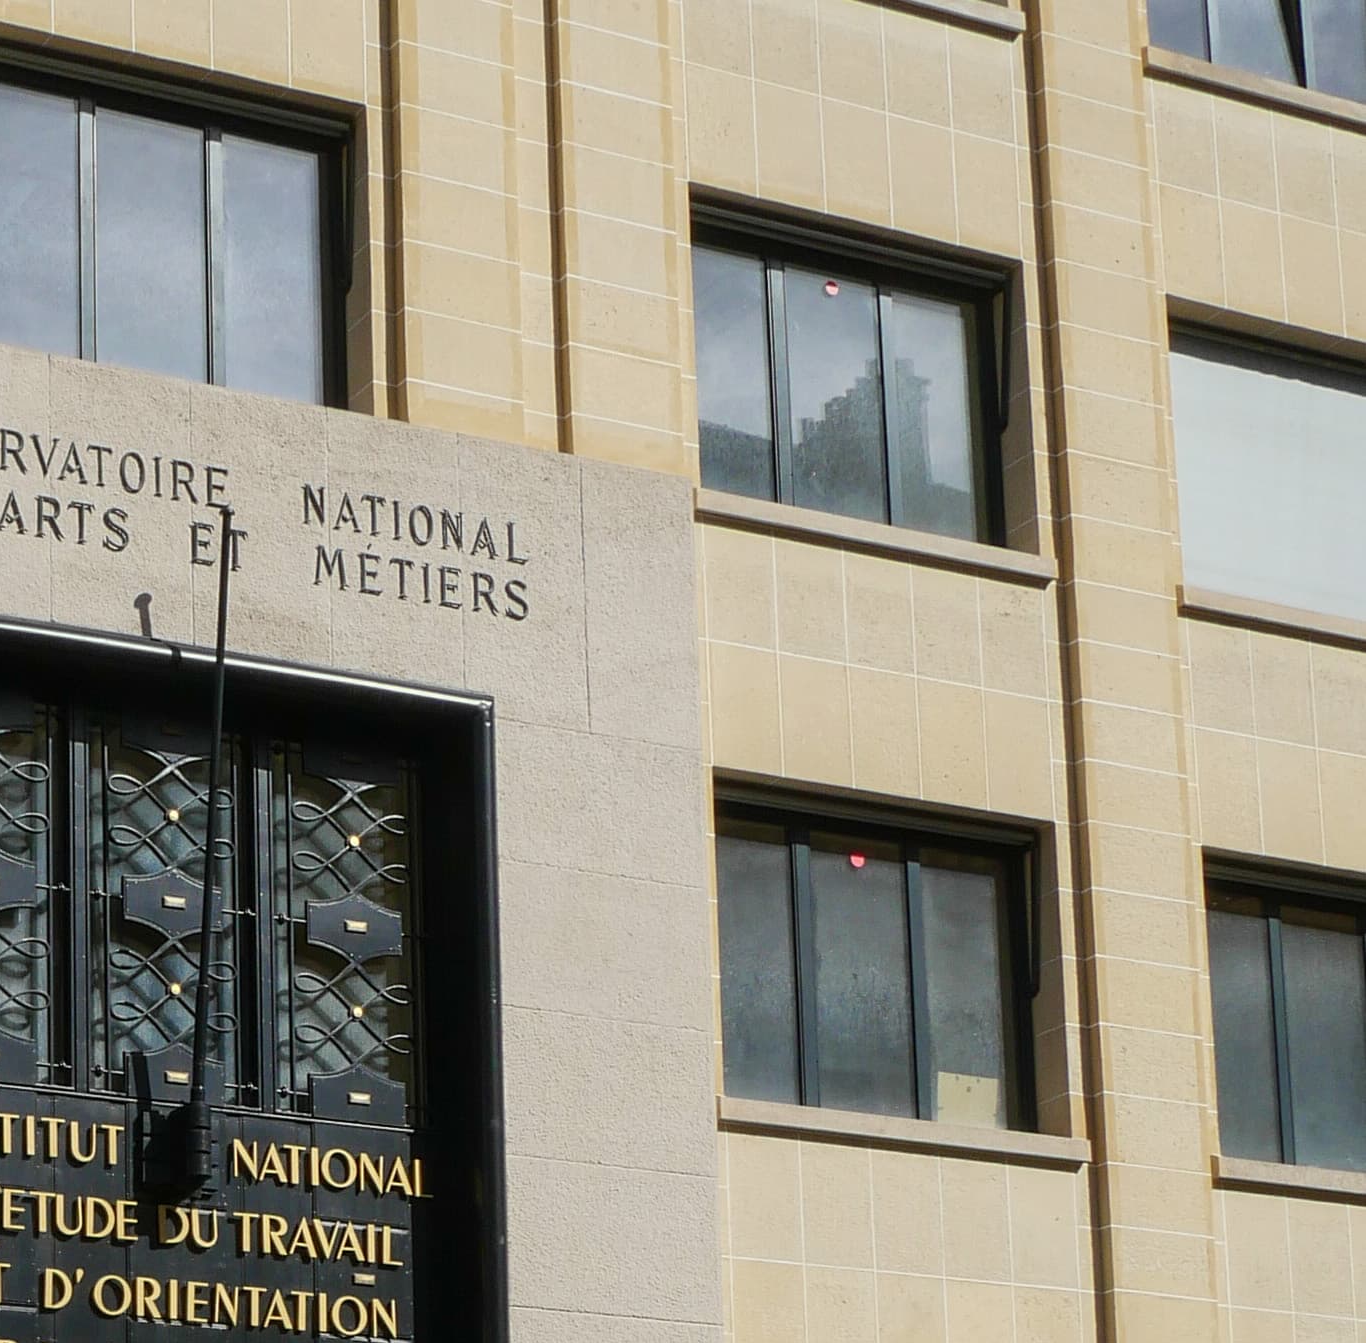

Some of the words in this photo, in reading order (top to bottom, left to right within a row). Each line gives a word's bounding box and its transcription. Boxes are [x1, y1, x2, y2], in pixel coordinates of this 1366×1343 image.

[302, 483, 530, 566] NATIONAL
[189, 520, 249, 572] ET
[313, 542, 530, 622] MÉTIERS
[232, 1137, 433, 1200] NATIONAL
[158, 1204, 218, 1248] DU
[233, 1211, 404, 1267] TRAVAIL
